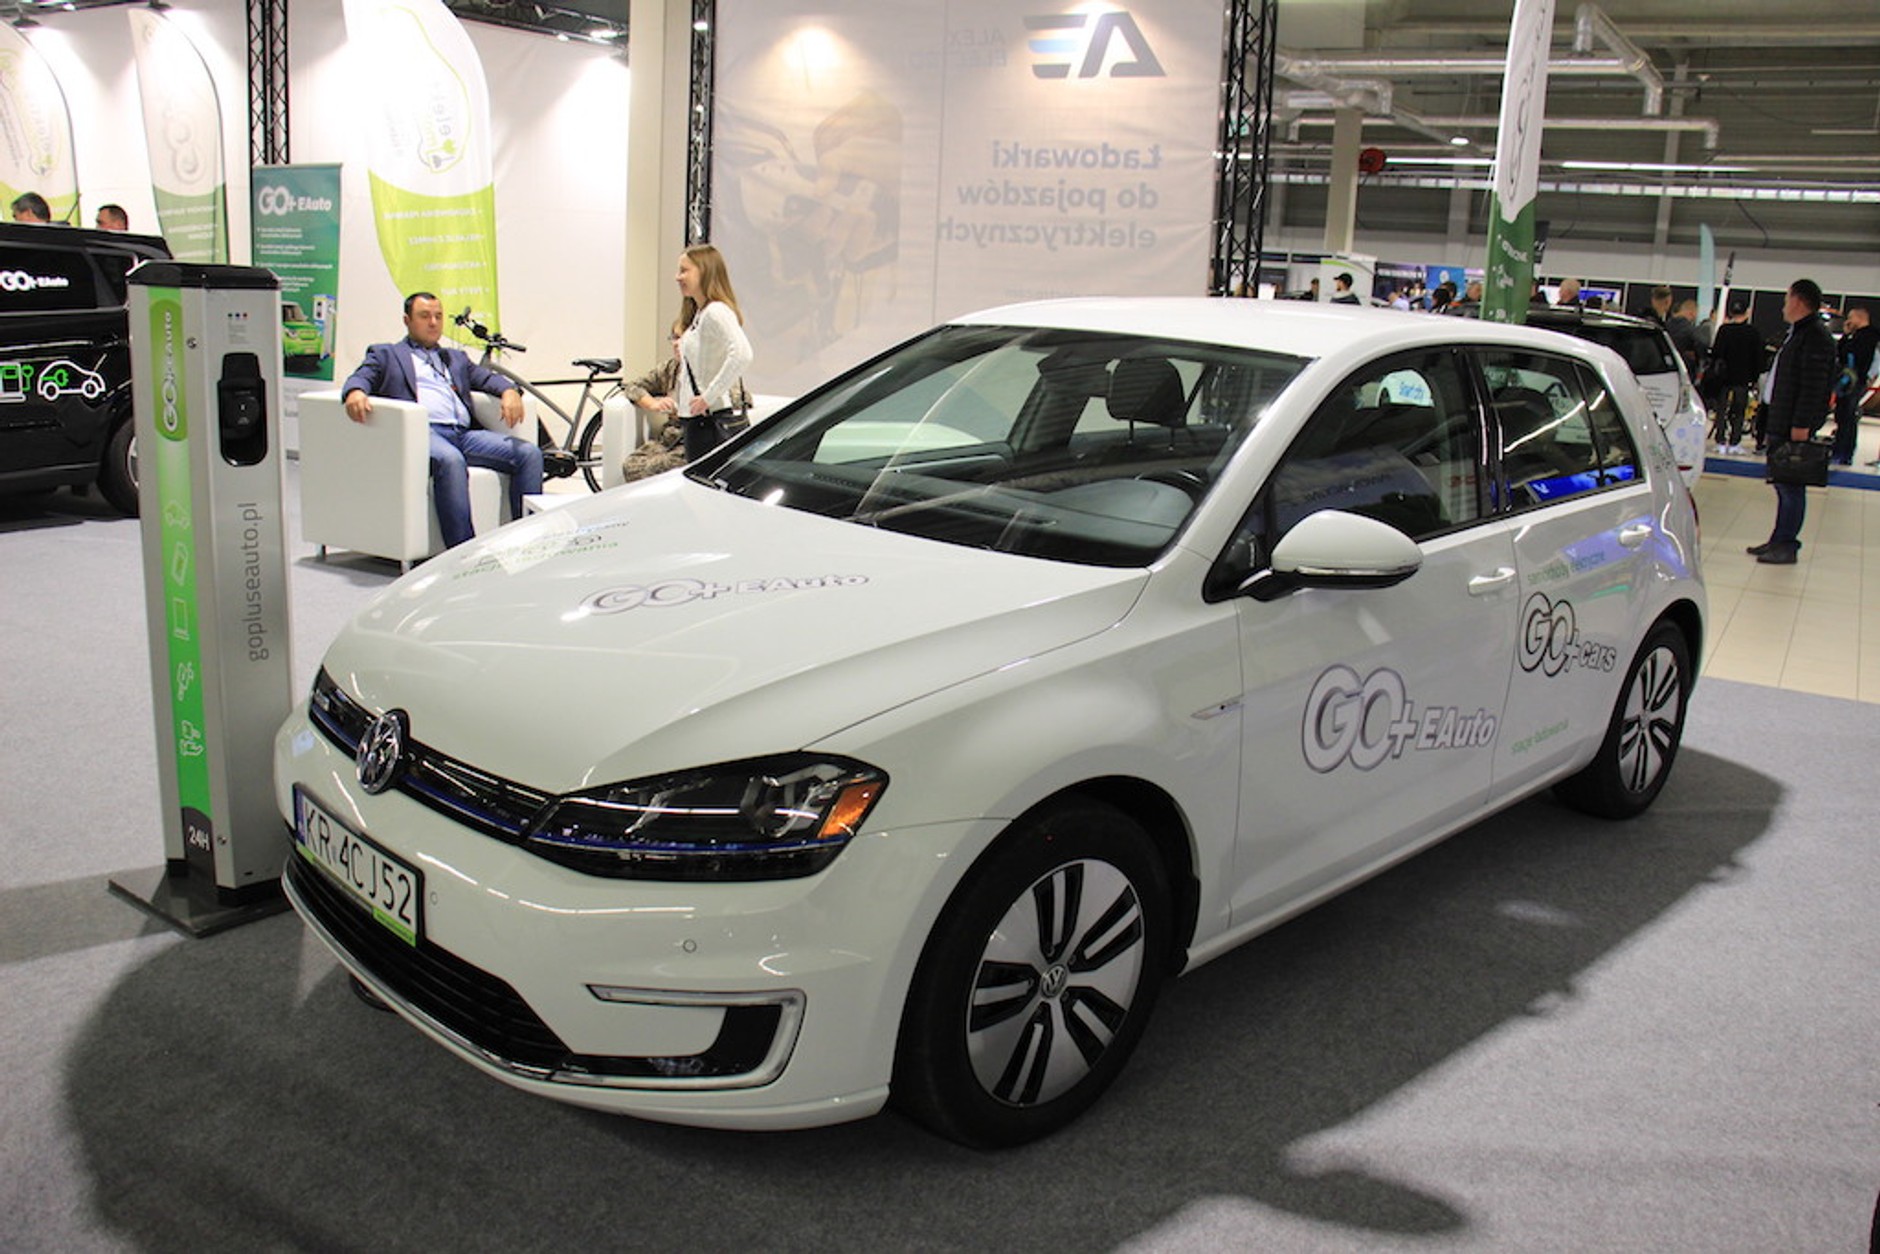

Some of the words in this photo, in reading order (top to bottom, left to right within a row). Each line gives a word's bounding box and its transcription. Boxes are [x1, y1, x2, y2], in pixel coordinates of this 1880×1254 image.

[237, 501, 269, 663] gopluseauto.pl
[188, 824, 211, 851] 24H
[304, 801, 333, 866] KR
[339, 834, 412, 925] 4CJ52
